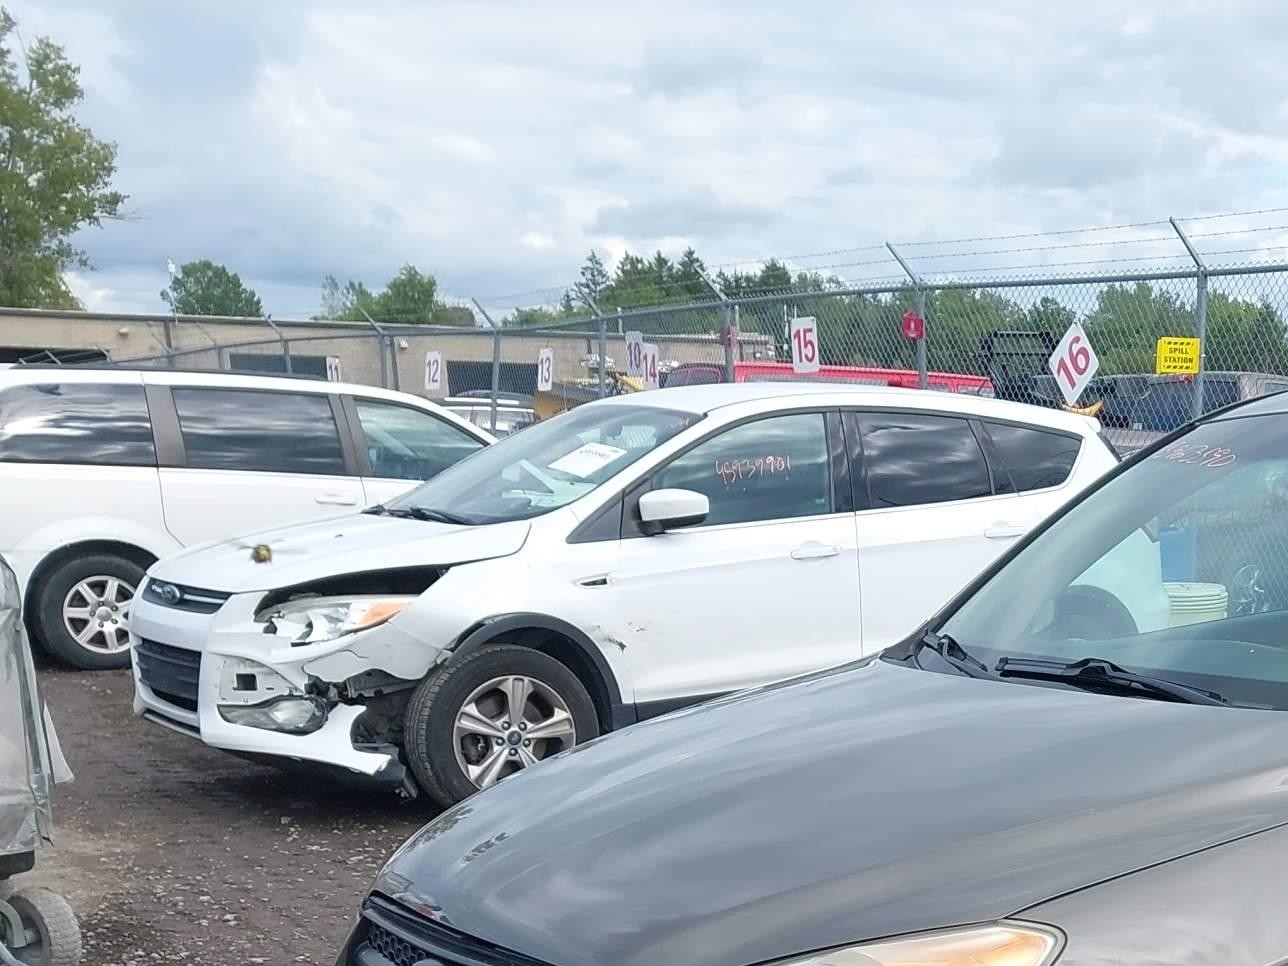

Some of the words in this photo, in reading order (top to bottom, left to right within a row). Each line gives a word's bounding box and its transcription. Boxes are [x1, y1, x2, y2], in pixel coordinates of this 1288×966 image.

[793, 327, 816, 364] 15
[1168, 347, 1190, 355] SPILL
[328, 364, 340, 382] 11
[426, 359, 440, 383] 12
[539, 356, 551, 383] 13
[642, 352, 657, 383] 14
[1056, 335, 1091, 391] 16
[1163, 356, 1194, 365] STATION
[715, 455, 791, 485] 45939901
